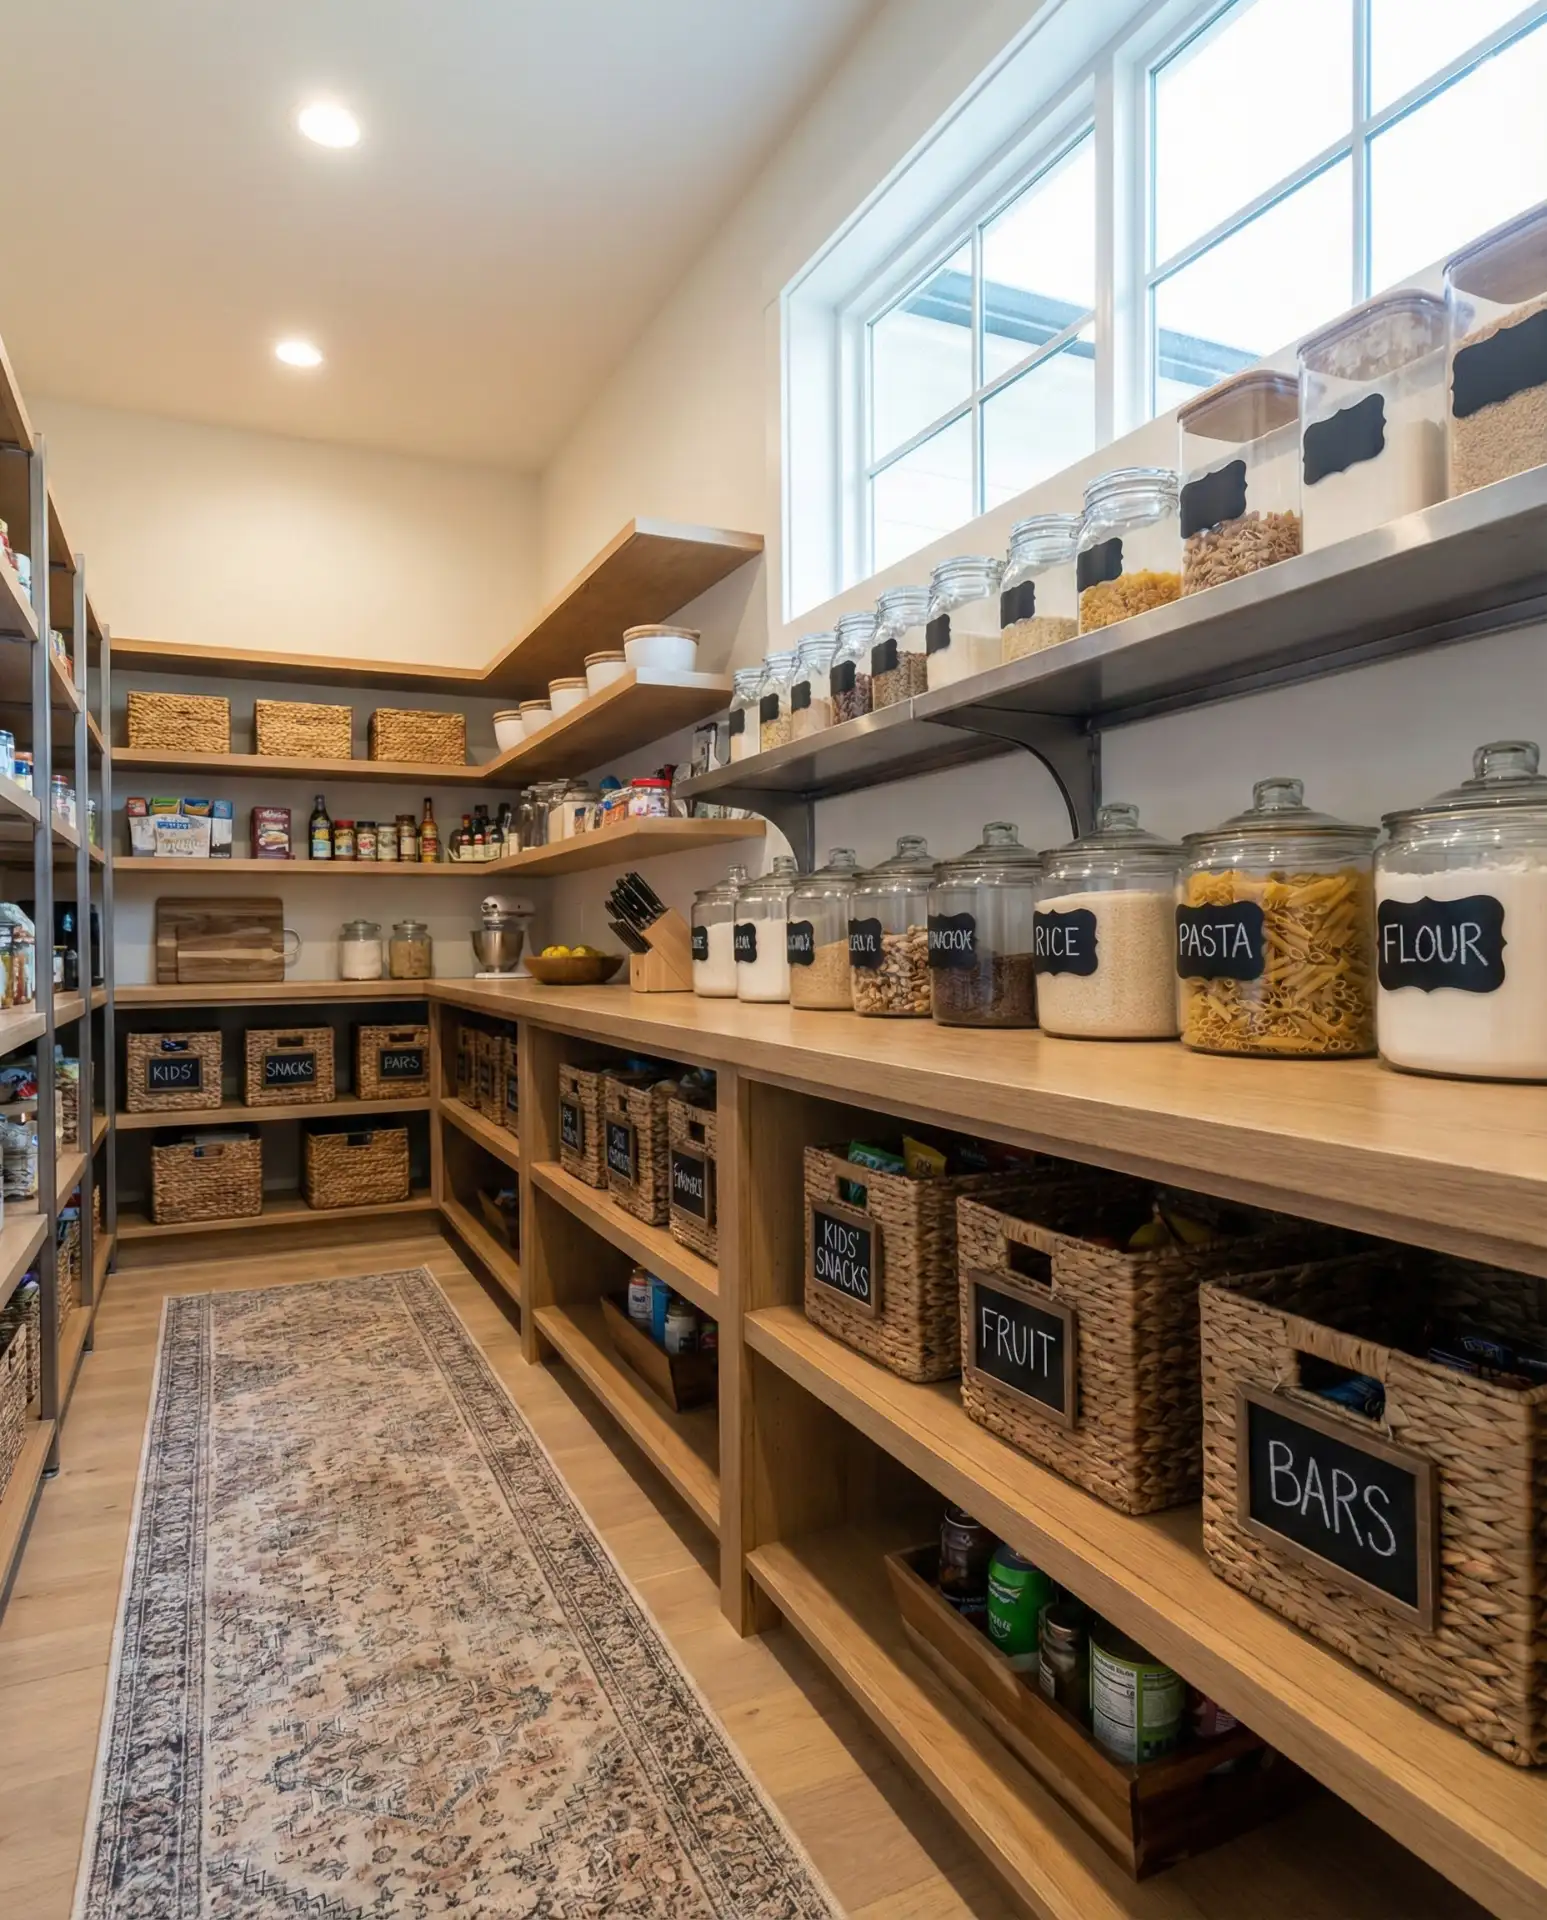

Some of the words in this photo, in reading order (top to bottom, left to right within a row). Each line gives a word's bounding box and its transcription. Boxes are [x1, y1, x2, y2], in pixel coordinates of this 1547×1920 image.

[1035, 924, 1081, 959] RICE
[1178, 922, 1253, 960] PASTA
[1383, 921, 1489, 967] FLOUR
[153, 1063, 193, 1081] KIDS'
[266, 1060, 314, 1077] SNACKS
[824, 1219, 861, 1259] KIDS'
[815, 1247, 869, 1297] SNACKS
[981, 1306, 1056, 1378] FRUIT
[1268, 1440, 1397, 1557] BARS
